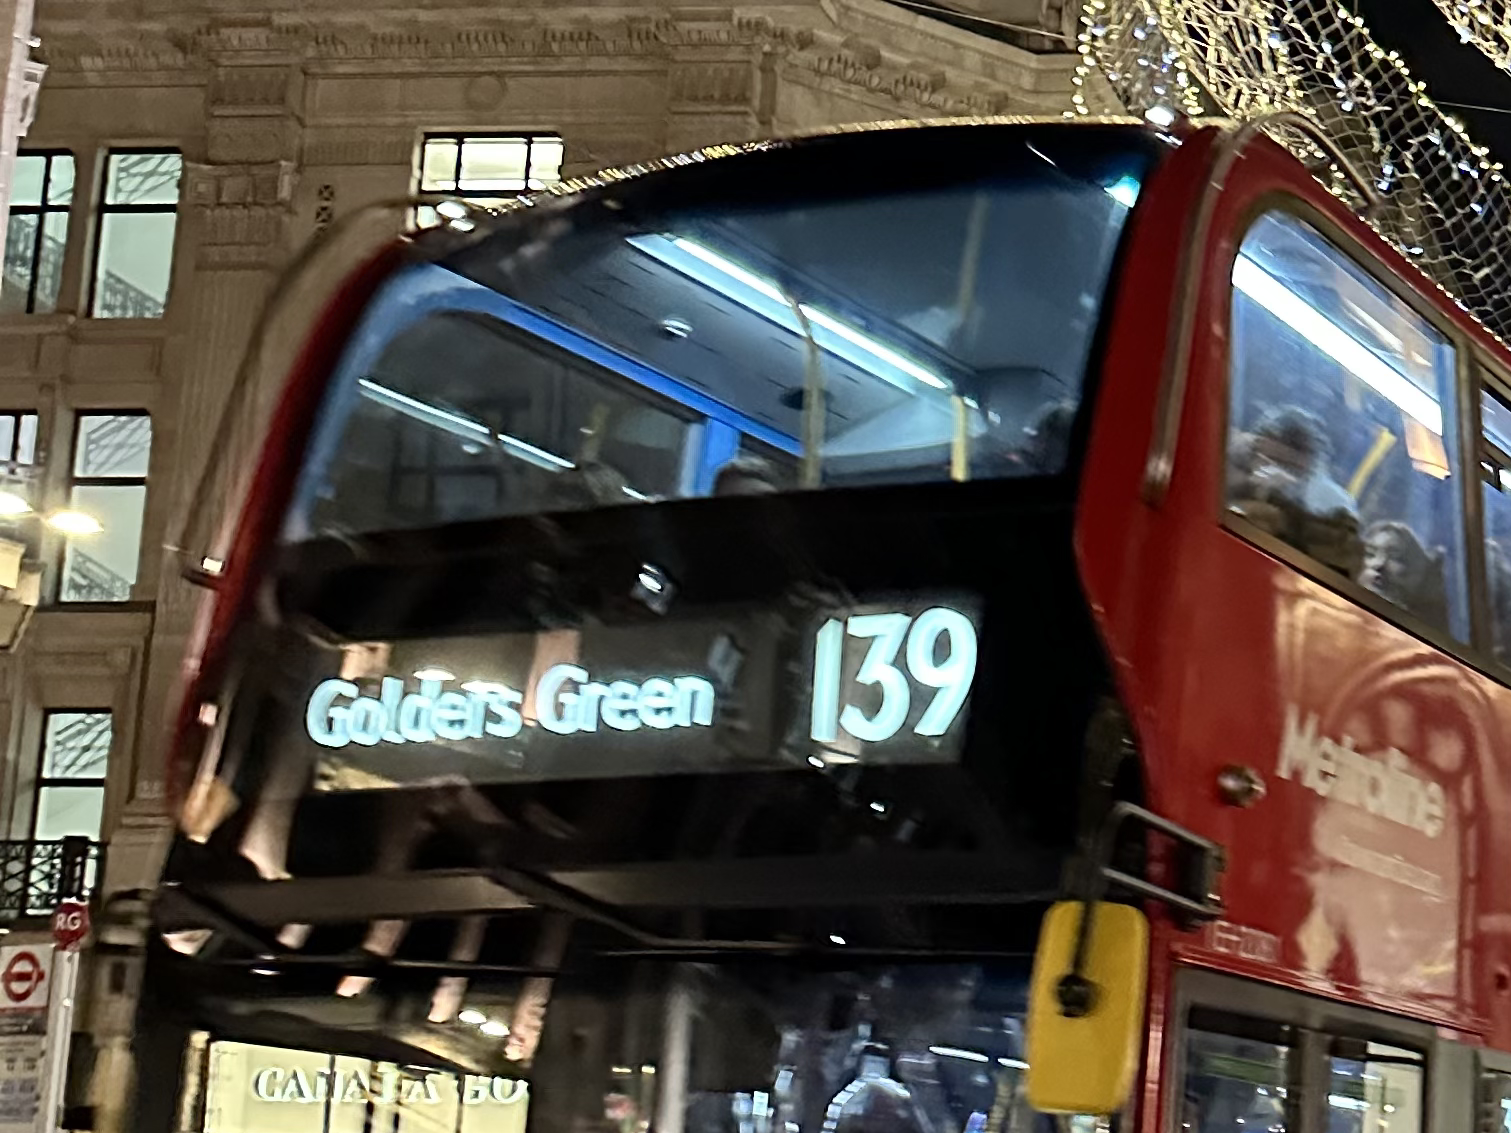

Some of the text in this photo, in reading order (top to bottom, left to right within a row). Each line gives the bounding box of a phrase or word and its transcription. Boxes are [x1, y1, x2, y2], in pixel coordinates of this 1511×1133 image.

[306, 664, 715, 748] Golders Green
[810, 607, 979, 743] 139
[1275, 702, 1446, 839] Metroline
[55, 912, 82, 931] RG
